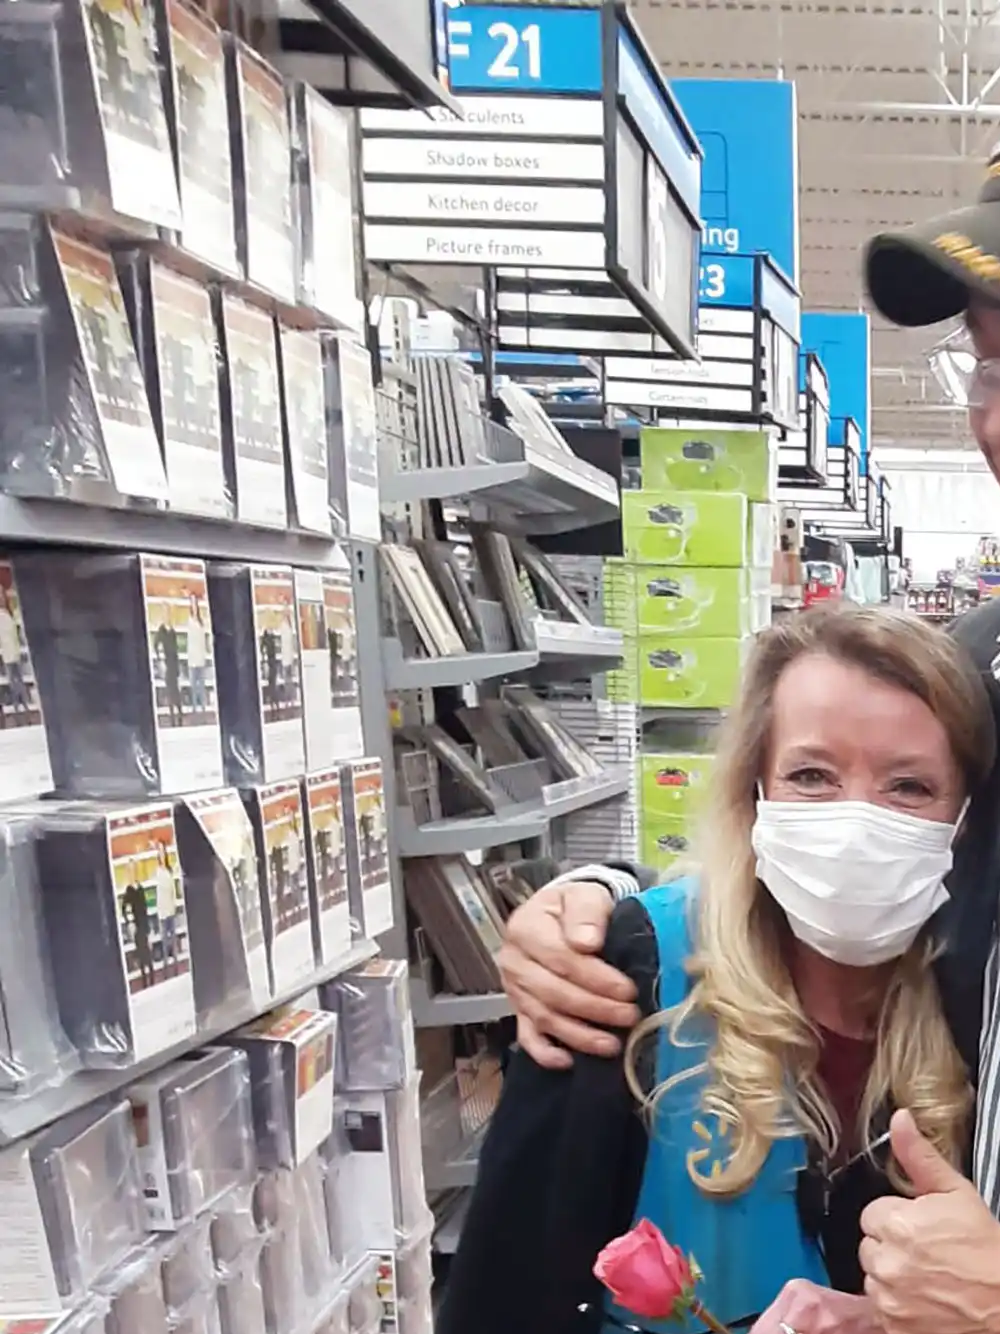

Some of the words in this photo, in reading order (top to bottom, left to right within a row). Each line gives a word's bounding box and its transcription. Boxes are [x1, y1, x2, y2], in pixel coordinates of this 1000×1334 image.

[486, 21, 542, 79] 21
[439, 107, 525, 125] Suculents
[427, 150, 489, 168] Shadow
[493, 151, 541, 170] boxes
[427, 194, 490, 212] Kitchen
[493, 196, 540, 213] decor
[425, 237, 485, 255] Picture
[487, 239, 543, 257] frames
[700, 264, 726, 297] 3
